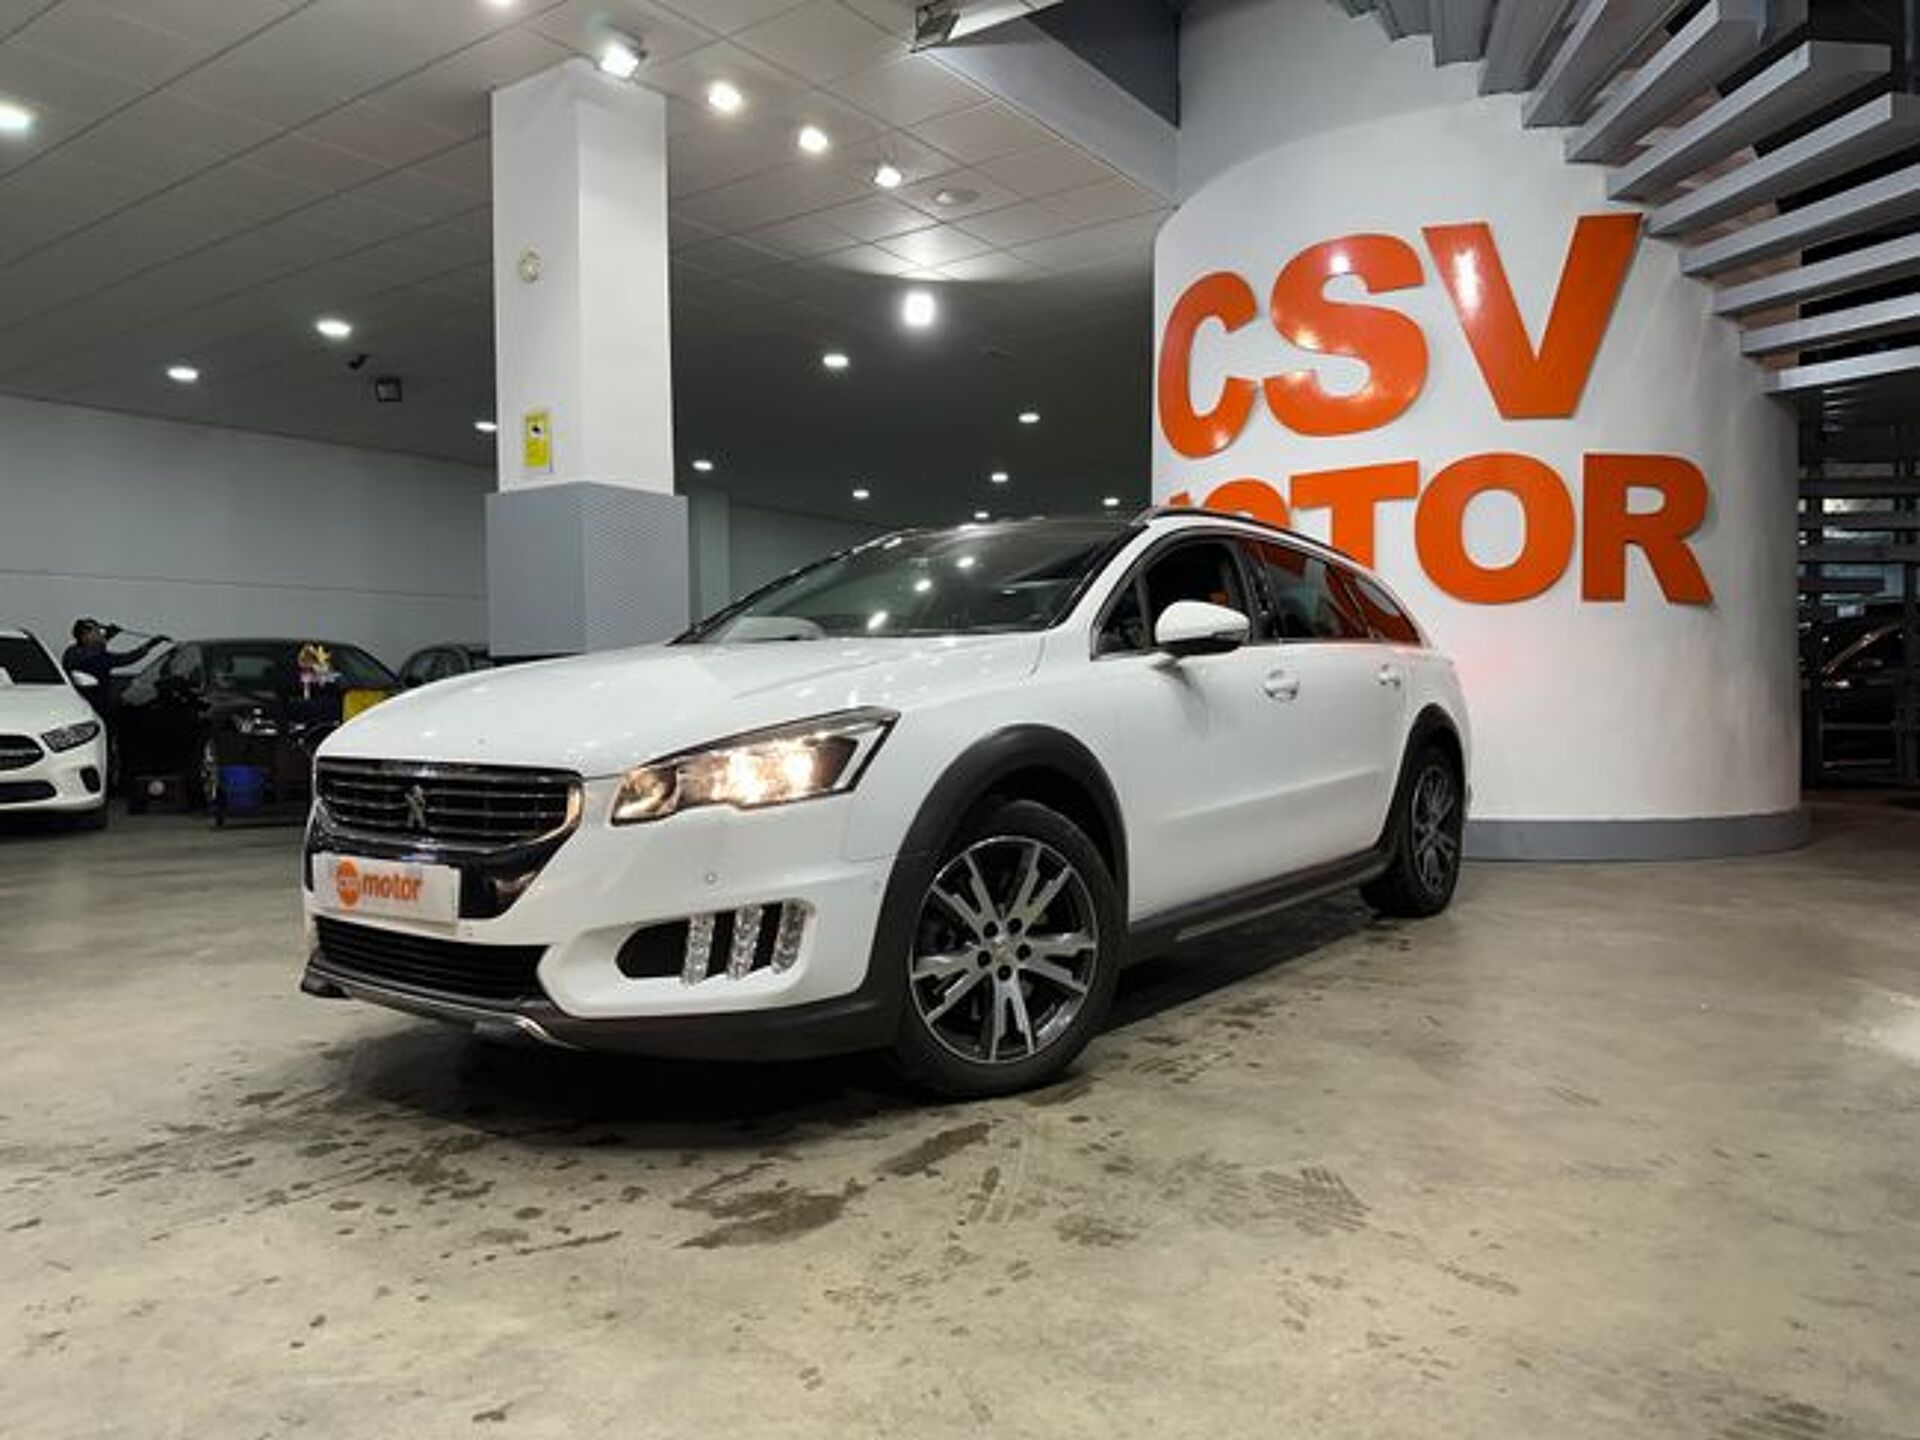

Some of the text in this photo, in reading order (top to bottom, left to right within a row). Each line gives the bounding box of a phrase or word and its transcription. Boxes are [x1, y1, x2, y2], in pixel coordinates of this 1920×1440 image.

[1158, 213, 1643, 459] CSV
[1168, 453, 1713, 606] TOR
[363, 874, 422, 900] motor
